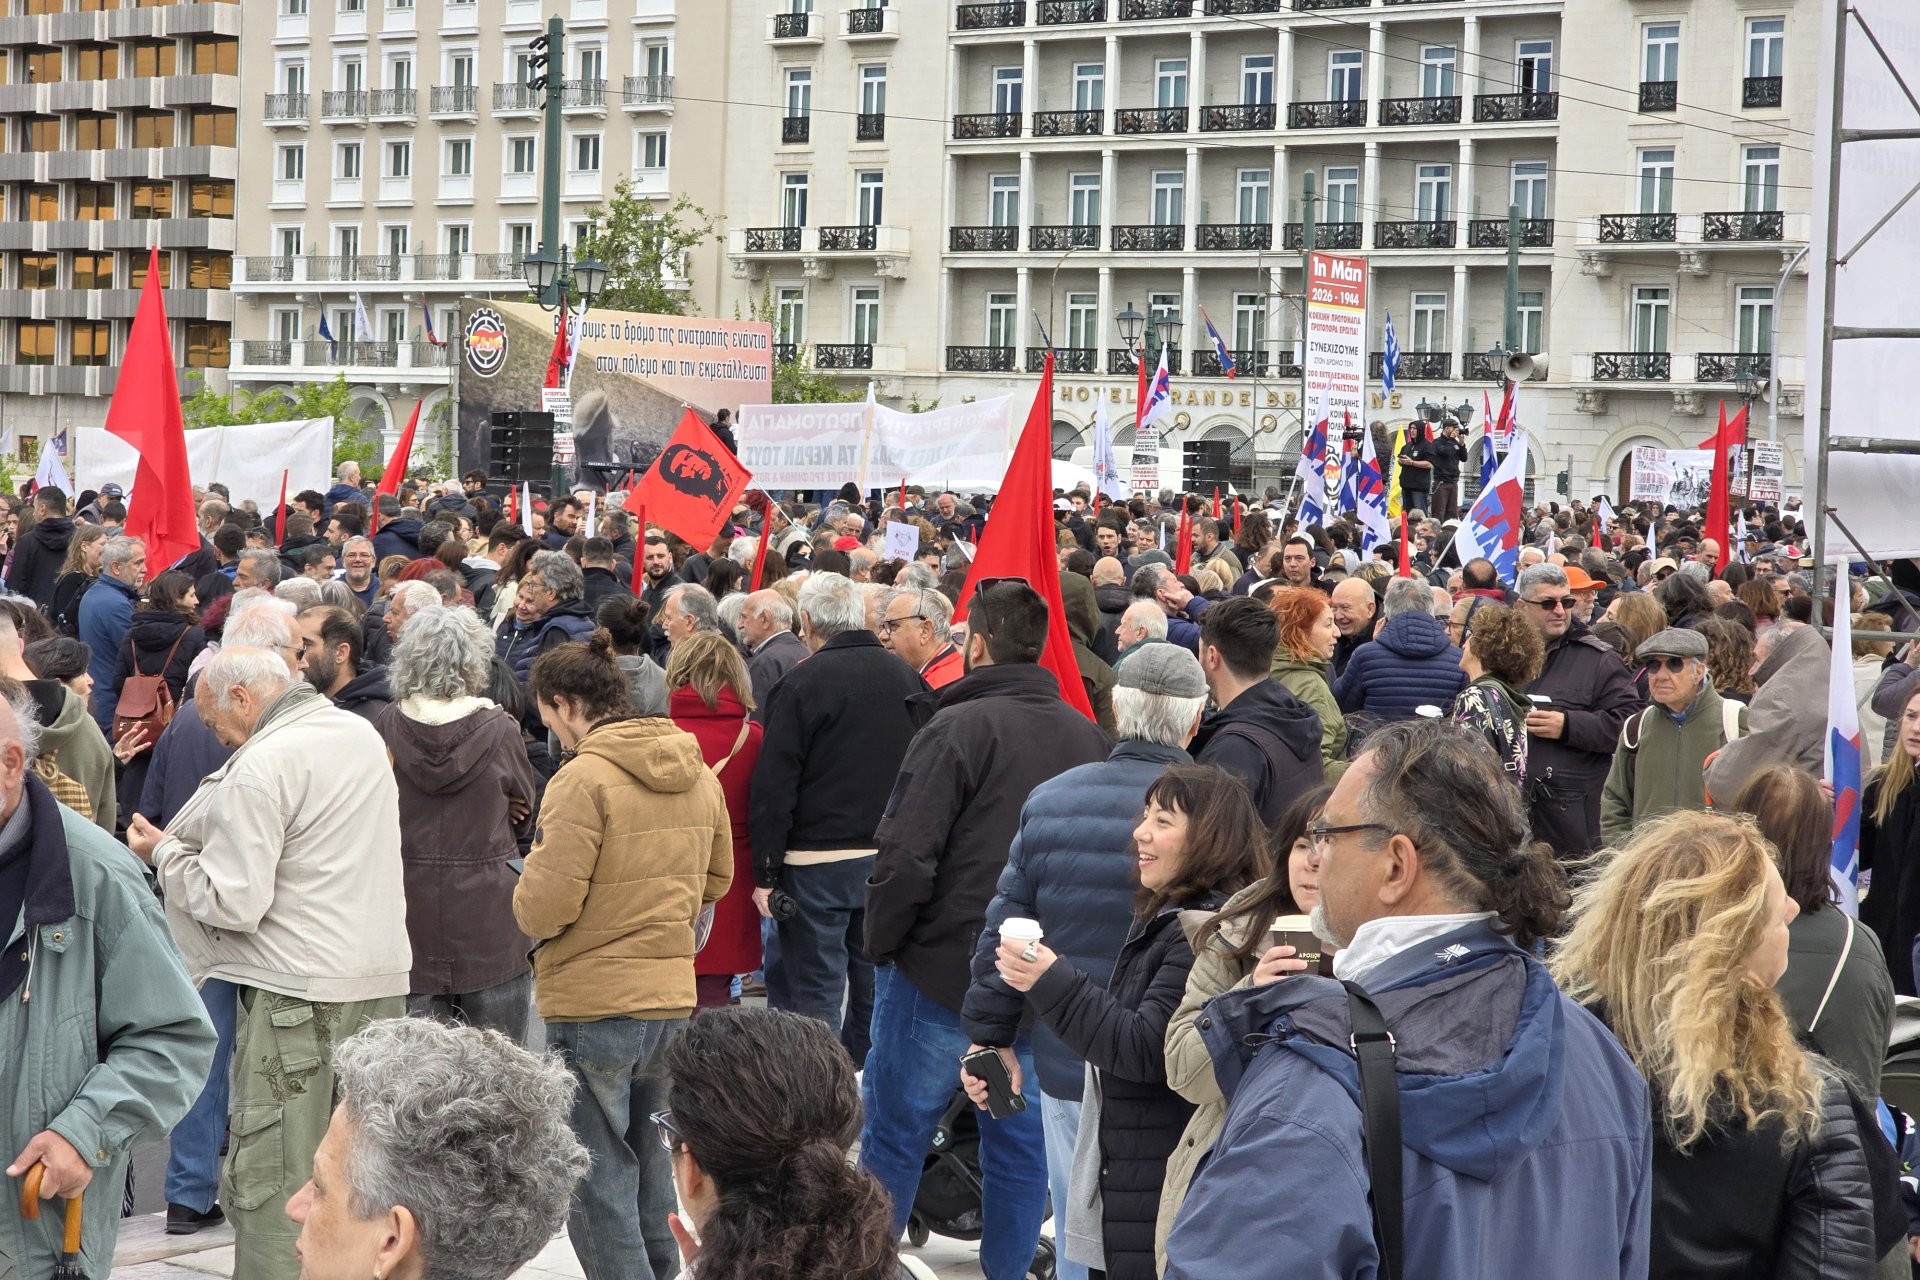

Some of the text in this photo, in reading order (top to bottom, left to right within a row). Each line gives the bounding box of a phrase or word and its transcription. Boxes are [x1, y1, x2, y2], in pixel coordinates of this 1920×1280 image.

[1312, 287, 1333, 302] 2026
[1340, 291, 1360, 306] 1944
[610, 323, 621, 340] το
[624, 319, 655, 346] δρόμο
[657, 326, 674, 347] της
[678, 327, 728, 350] ανατροπής
[732, 329, 767, 349] ενάντια
[1310, 341, 1359, 356] ΣΥΝΕΧΙΖΟΥΜΕ
[596, 353, 767, 382] στον πόλεμο και την εκμετάλλευση
[1307, 369, 1318, 377] 200
[1170, 389, 1251, 407] RANDE
[1308, 396, 1319, 404] ΤΗΣ
